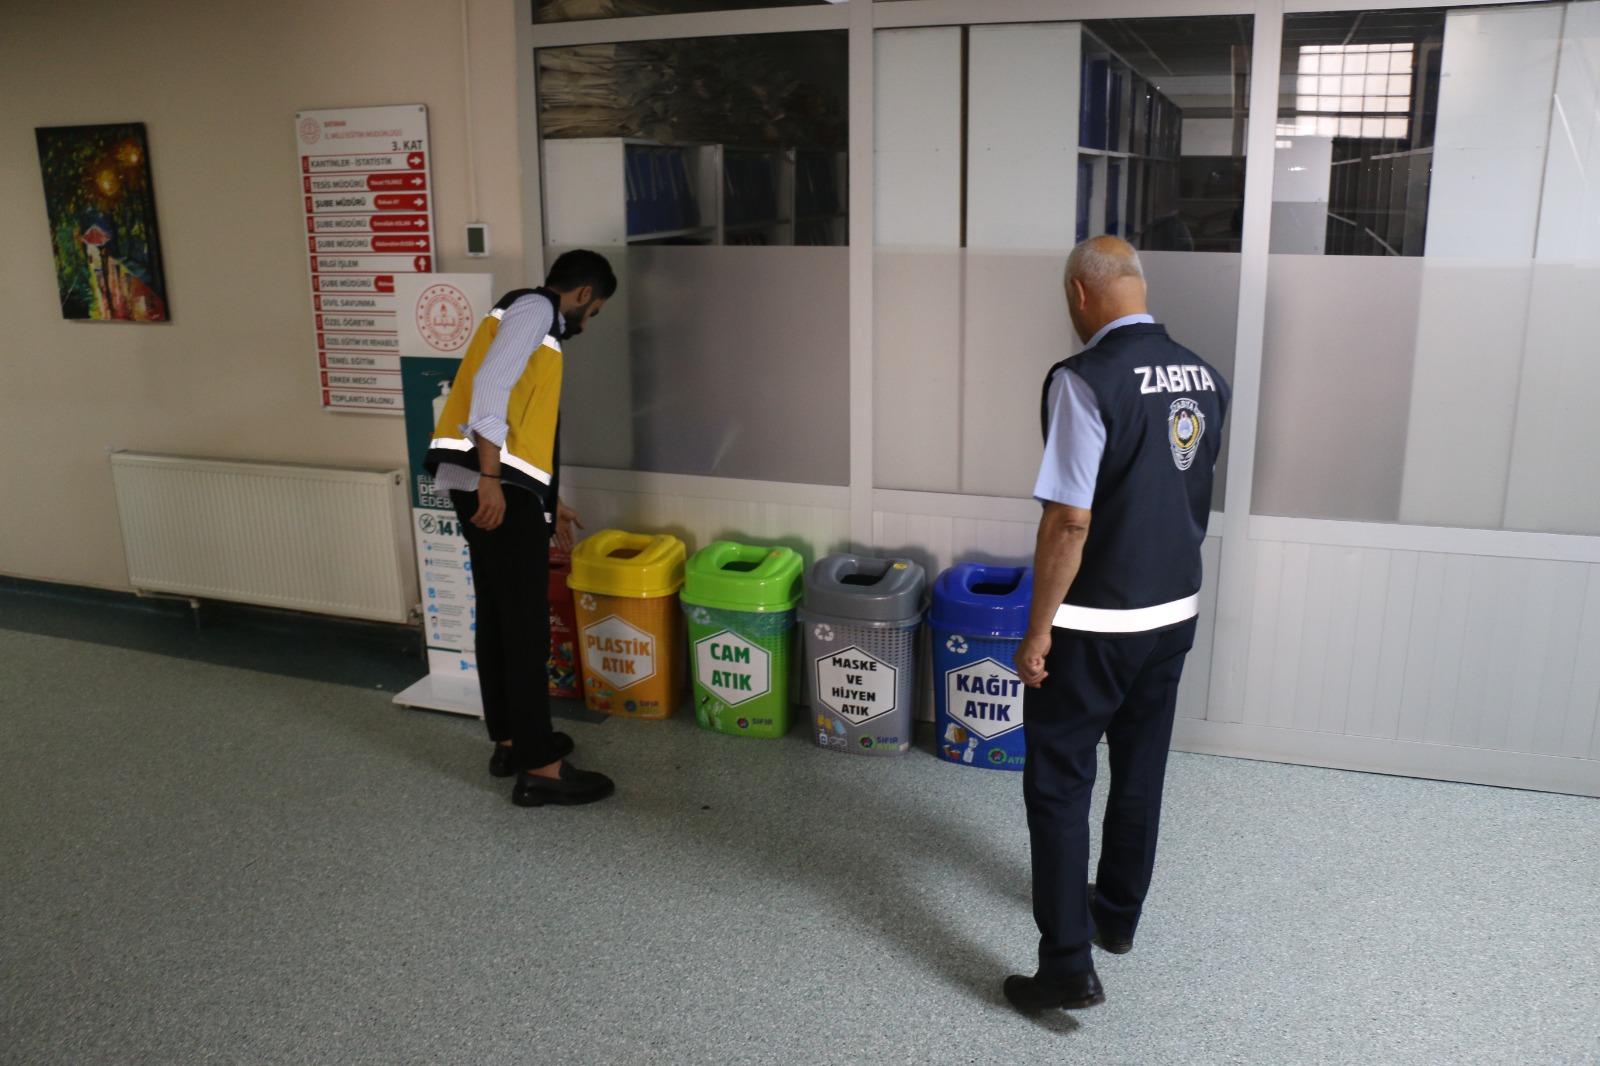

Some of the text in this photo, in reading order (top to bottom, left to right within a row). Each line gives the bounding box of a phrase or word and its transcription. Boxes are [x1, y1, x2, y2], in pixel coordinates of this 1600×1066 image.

[392, 140, 423, 151] 3. KAT
[311, 158, 350, 168] KANTİNLER
[355, 157, 392, 167] İSTATİSTİK
[336, 197, 366, 206] MÜDÜRÜ
[336, 218, 367, 227] MÜDÜRÜ
[337, 238, 368, 248] MÜDÜRÜ
[1134, 364, 1216, 395] ZABITA
[438, 520, 454, 536] 14
[586, 635, 651, 657] PLASTİK
[710, 642, 751, 665] CAM
[602, 656, 636, 675] ATIK
[832, 656, 877, 671] MASKE
[711, 669, 752, 691] ATIK
[846, 674, 863, 685] VE
[956, 674, 1021, 698] KAĞIT
[832, 686, 876, 702] HİJYEN
[841, 703, 869, 716] ATIK
[964, 700, 1011, 722] ATIK
